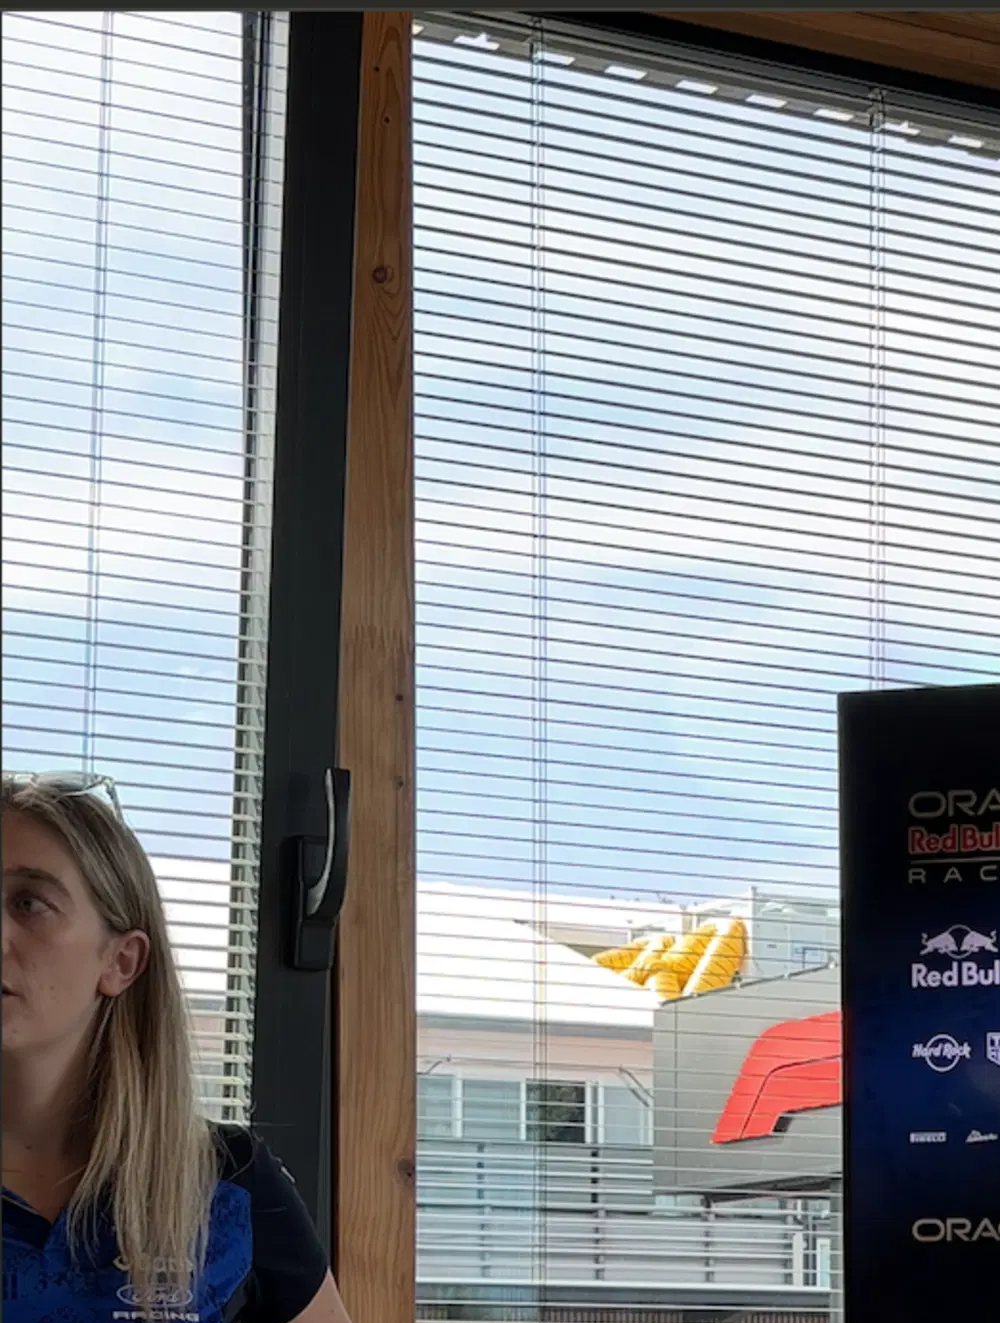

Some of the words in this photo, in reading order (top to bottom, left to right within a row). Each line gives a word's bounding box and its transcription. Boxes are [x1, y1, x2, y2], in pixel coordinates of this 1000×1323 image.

[908, 824, 959, 854] Red
[911, 961, 959, 988] Red
[911, 1042, 943, 1058] Hard
[943, 1042, 972, 1060] Rock
